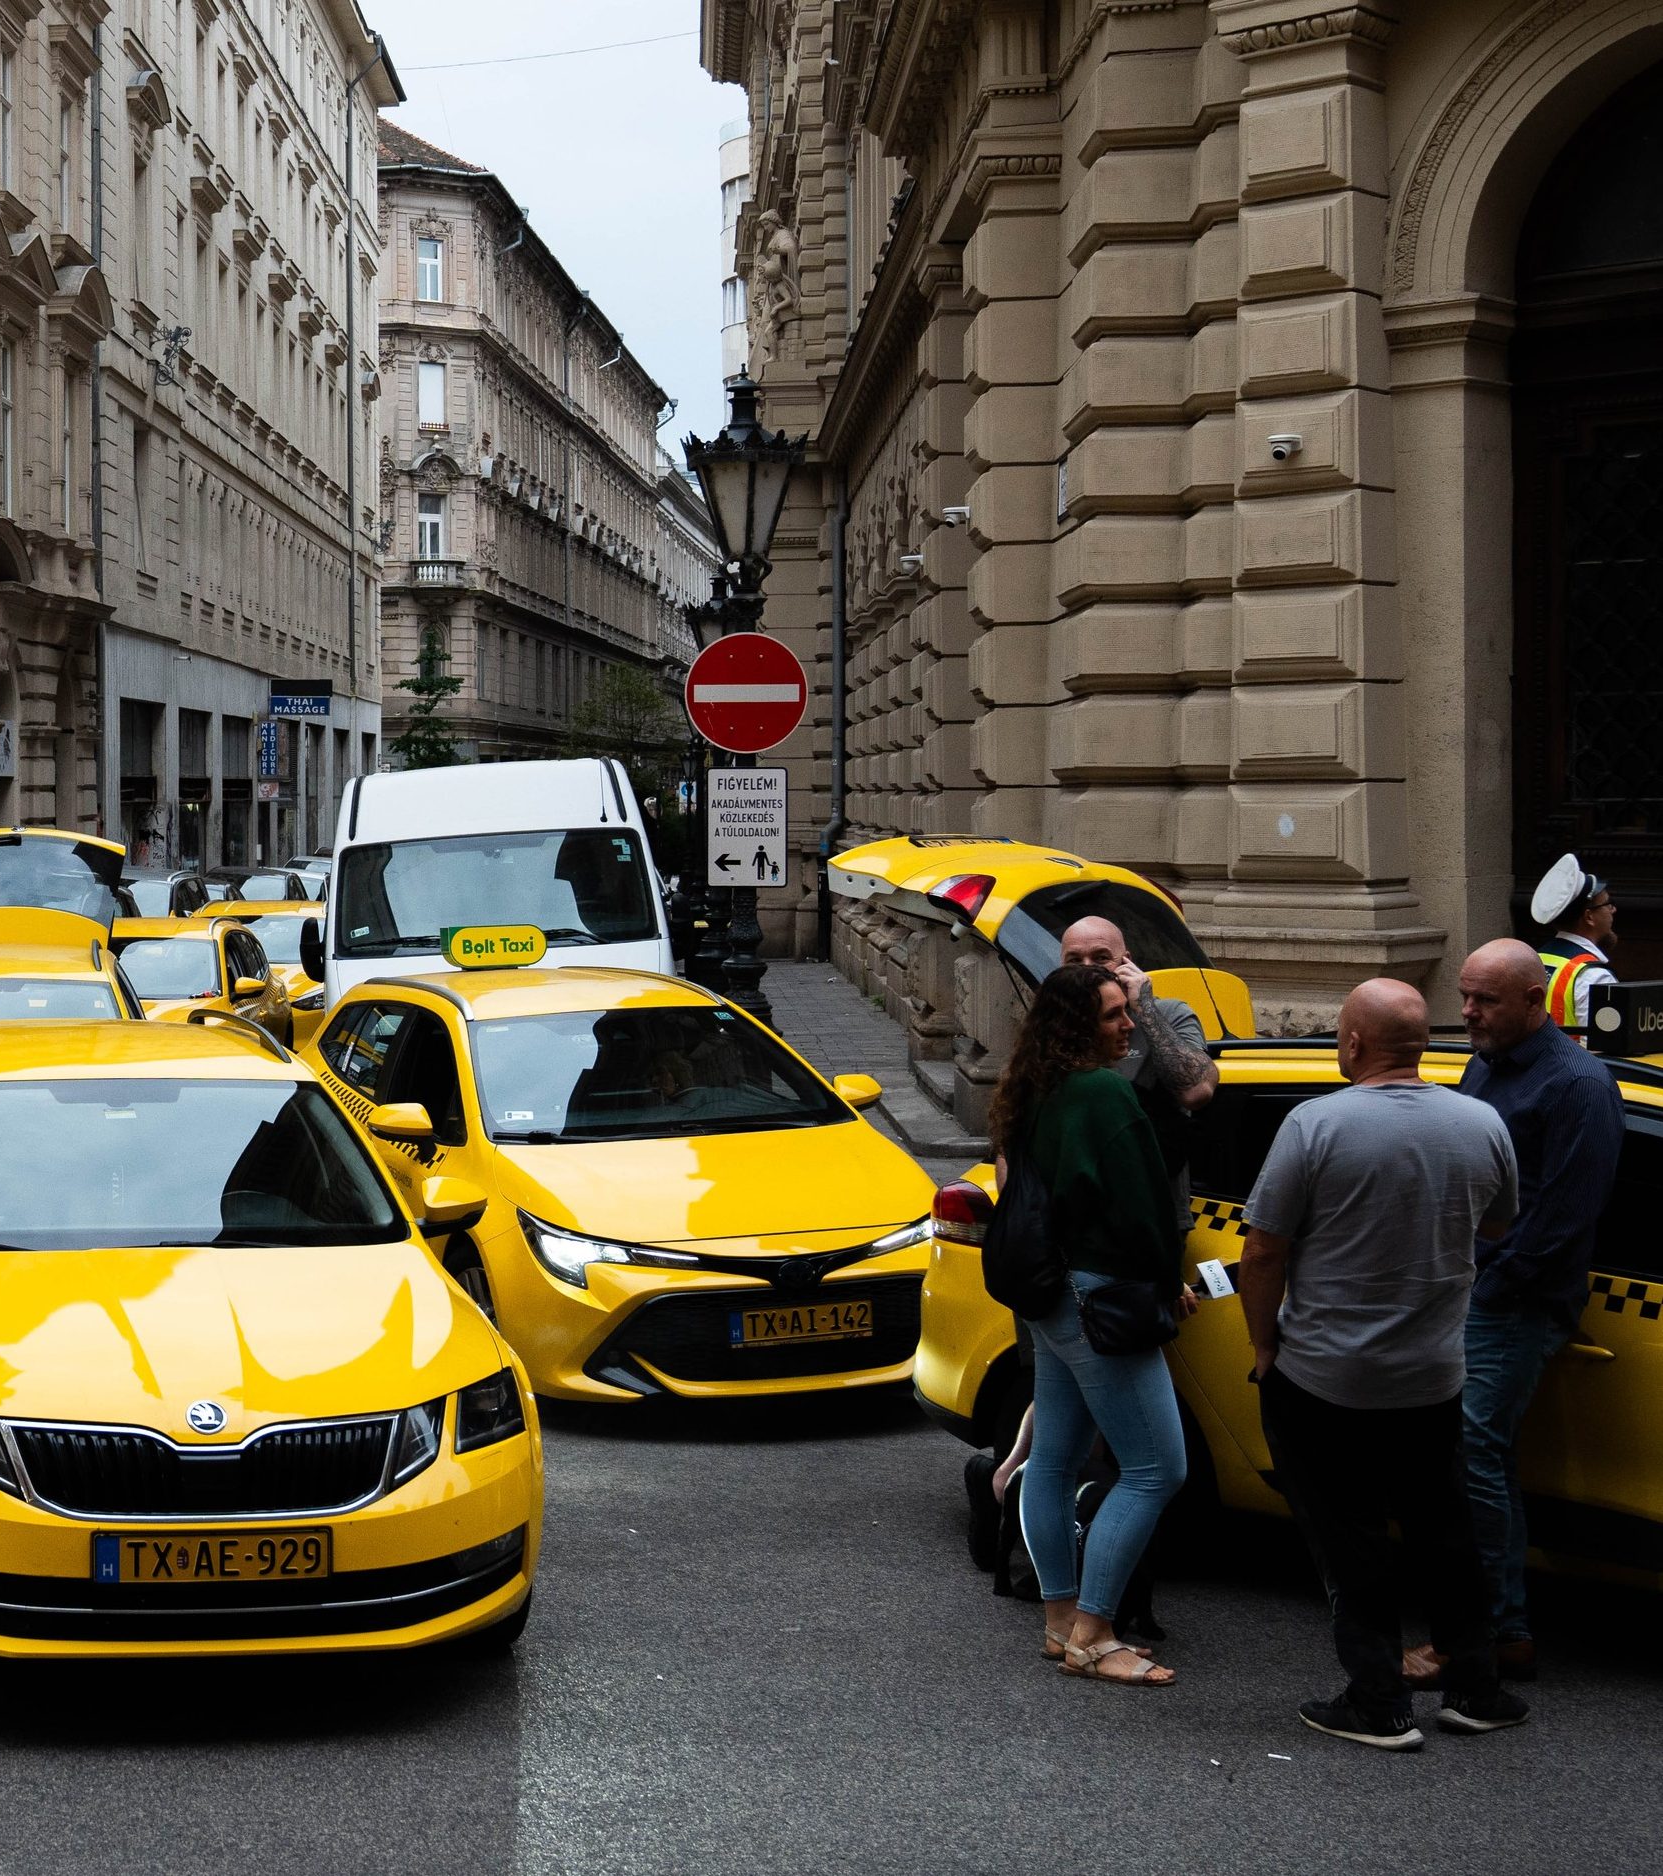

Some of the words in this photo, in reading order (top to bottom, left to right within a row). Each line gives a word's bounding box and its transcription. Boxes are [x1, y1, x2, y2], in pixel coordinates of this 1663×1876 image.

[287, 698, 313, 706] THAI
[274, 706, 326, 714] MASSAGE
[261, 723, 269, 775] MANICURE
[269, 723, 277, 775] PEDICURE
[717, 778, 777, 790] FIGYELEM!
[711, 797, 783, 809] AKADÁLYMENTES
[720, 811, 775, 823] KÖZLEKEDÉS
[714, 828, 720, 837] A
[722, 825, 779, 837] TÚLOLDALON!
[462, 938, 495, 958] Bolt
[500, 936, 534, 953] Taxi
[1638, 1006, 1663, 1032] Ube
[102, 1563, 113, 1577] H
